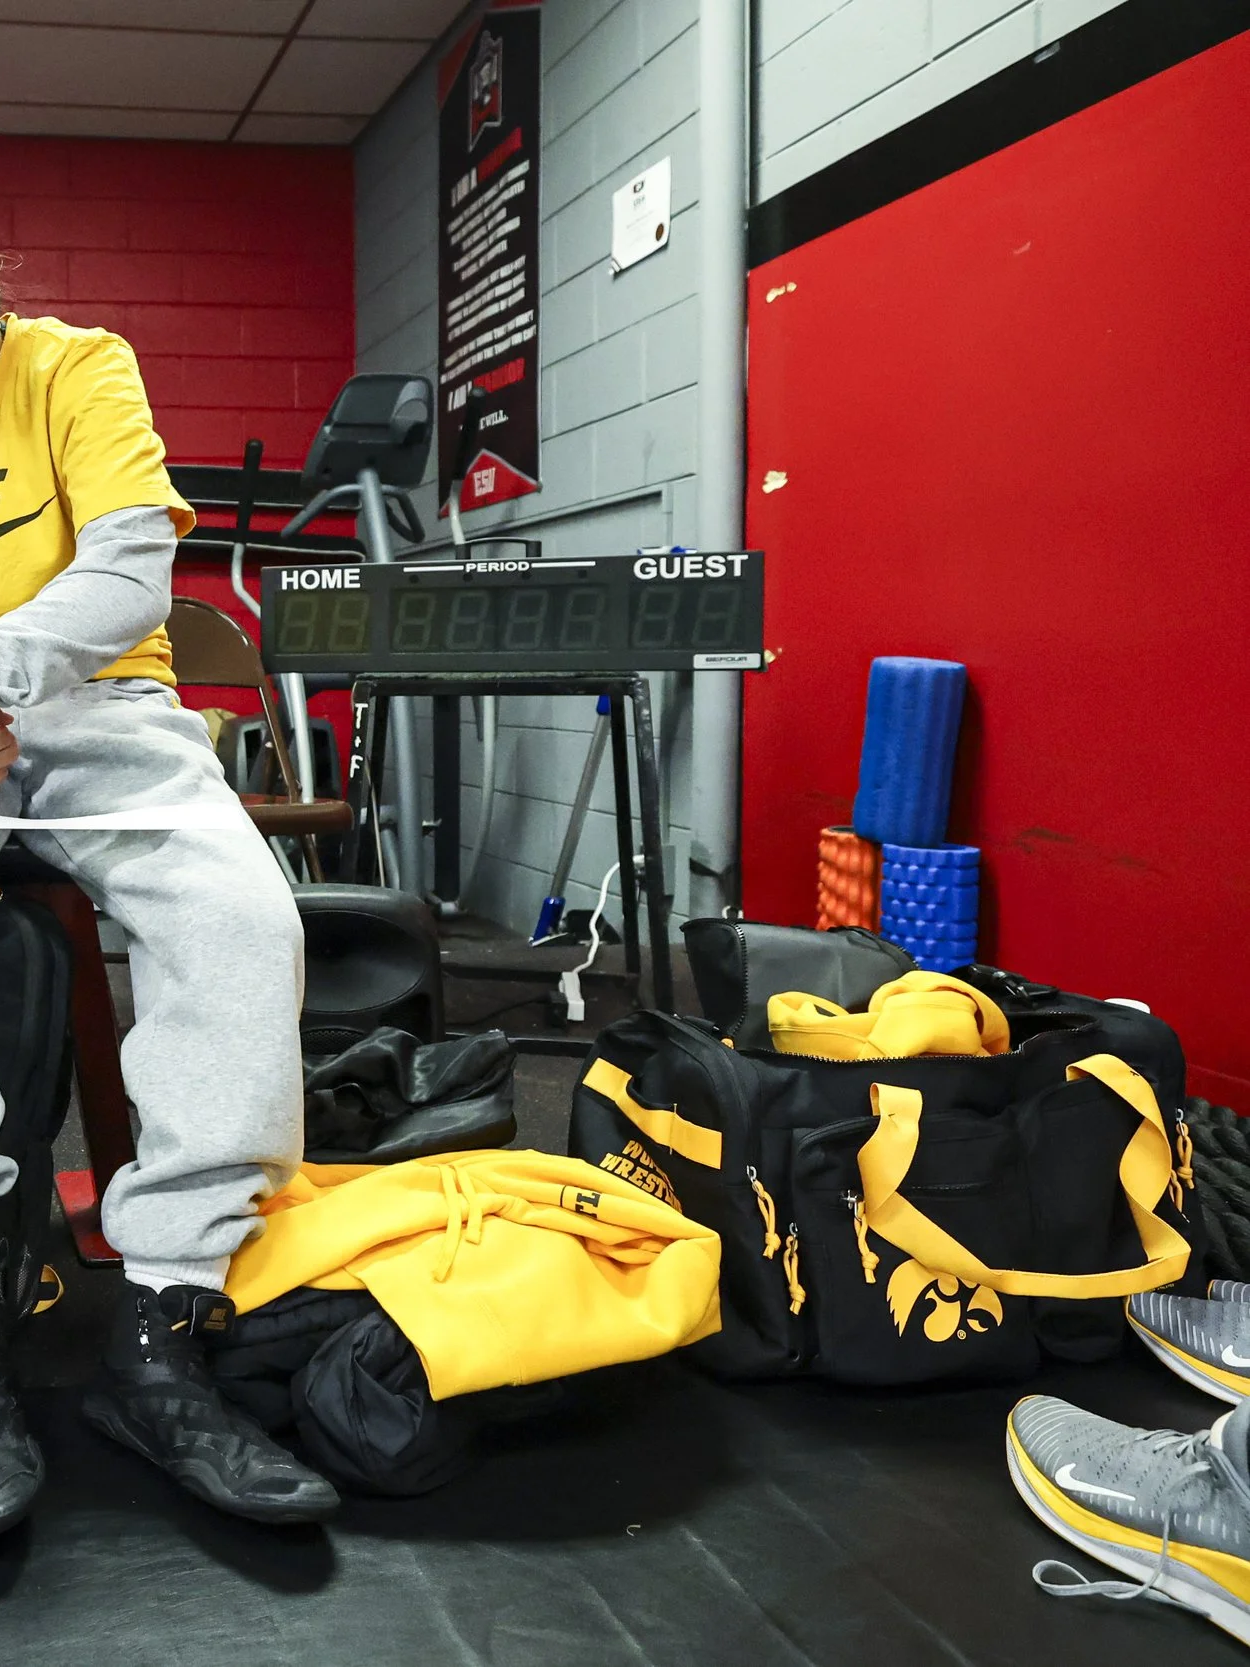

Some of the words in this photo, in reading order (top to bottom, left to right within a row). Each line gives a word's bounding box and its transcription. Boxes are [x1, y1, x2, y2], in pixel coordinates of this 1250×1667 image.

[473, 467, 496, 497] ESU
[281, 568, 361, 590] HOME
[465, 561, 531, 574] PERIOD
[633, 554, 749, 581] GUEST
